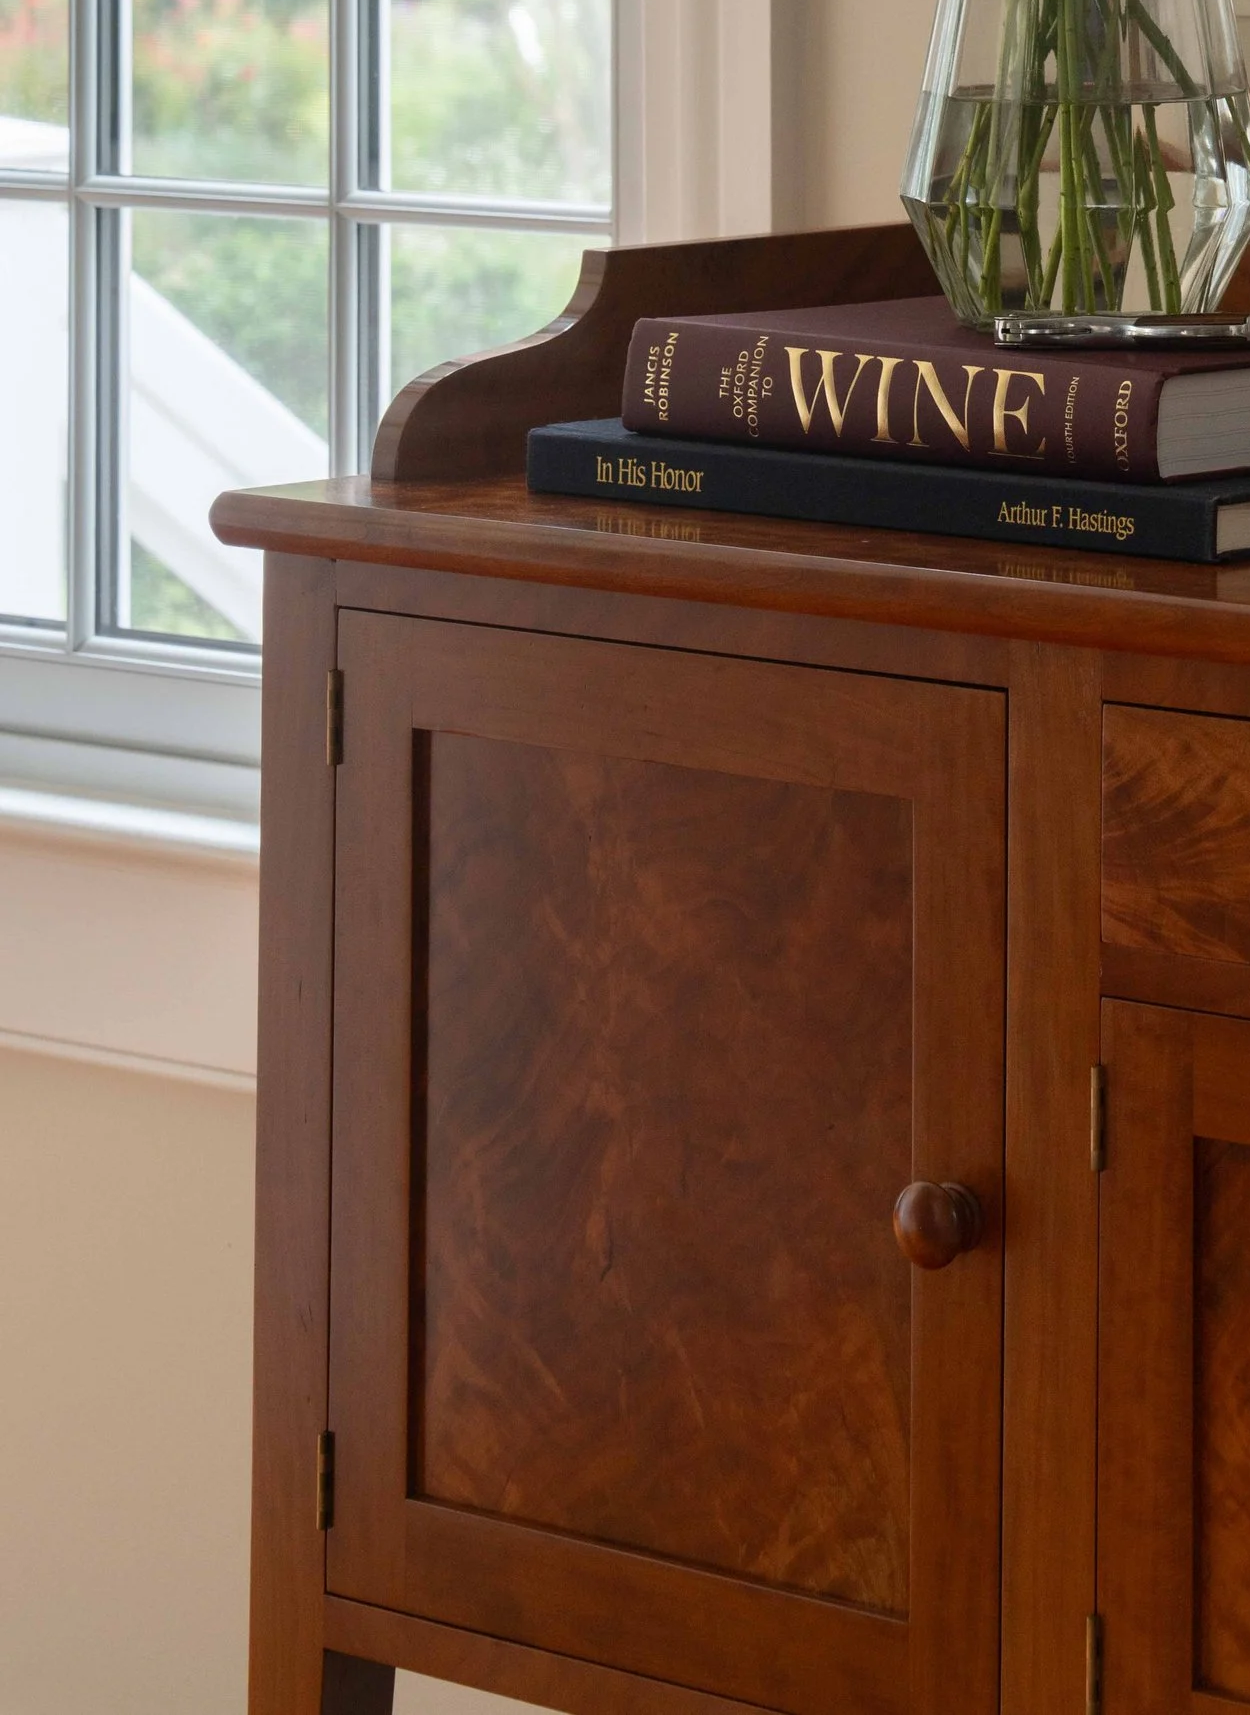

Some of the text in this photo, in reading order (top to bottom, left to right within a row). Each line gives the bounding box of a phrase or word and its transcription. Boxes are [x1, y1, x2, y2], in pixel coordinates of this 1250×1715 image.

[644, 346, 660, 405] JANCIS
[658, 332, 680, 422] ROBINSON
[719, 366, 733, 399] THE
[733, 350, 749, 418] OXFORD
[747, 335, 770, 438] COMPANION
[761, 376, 774, 399] TO
[784, 346, 1046, 460] WINE
[1064, 376, 1081, 412] EDITION
[1113, 379, 1133, 473] OXFORD
[595, 455, 705, 493] In His Honor
[996, 500, 1136, 541] Arthur F. Hastings
